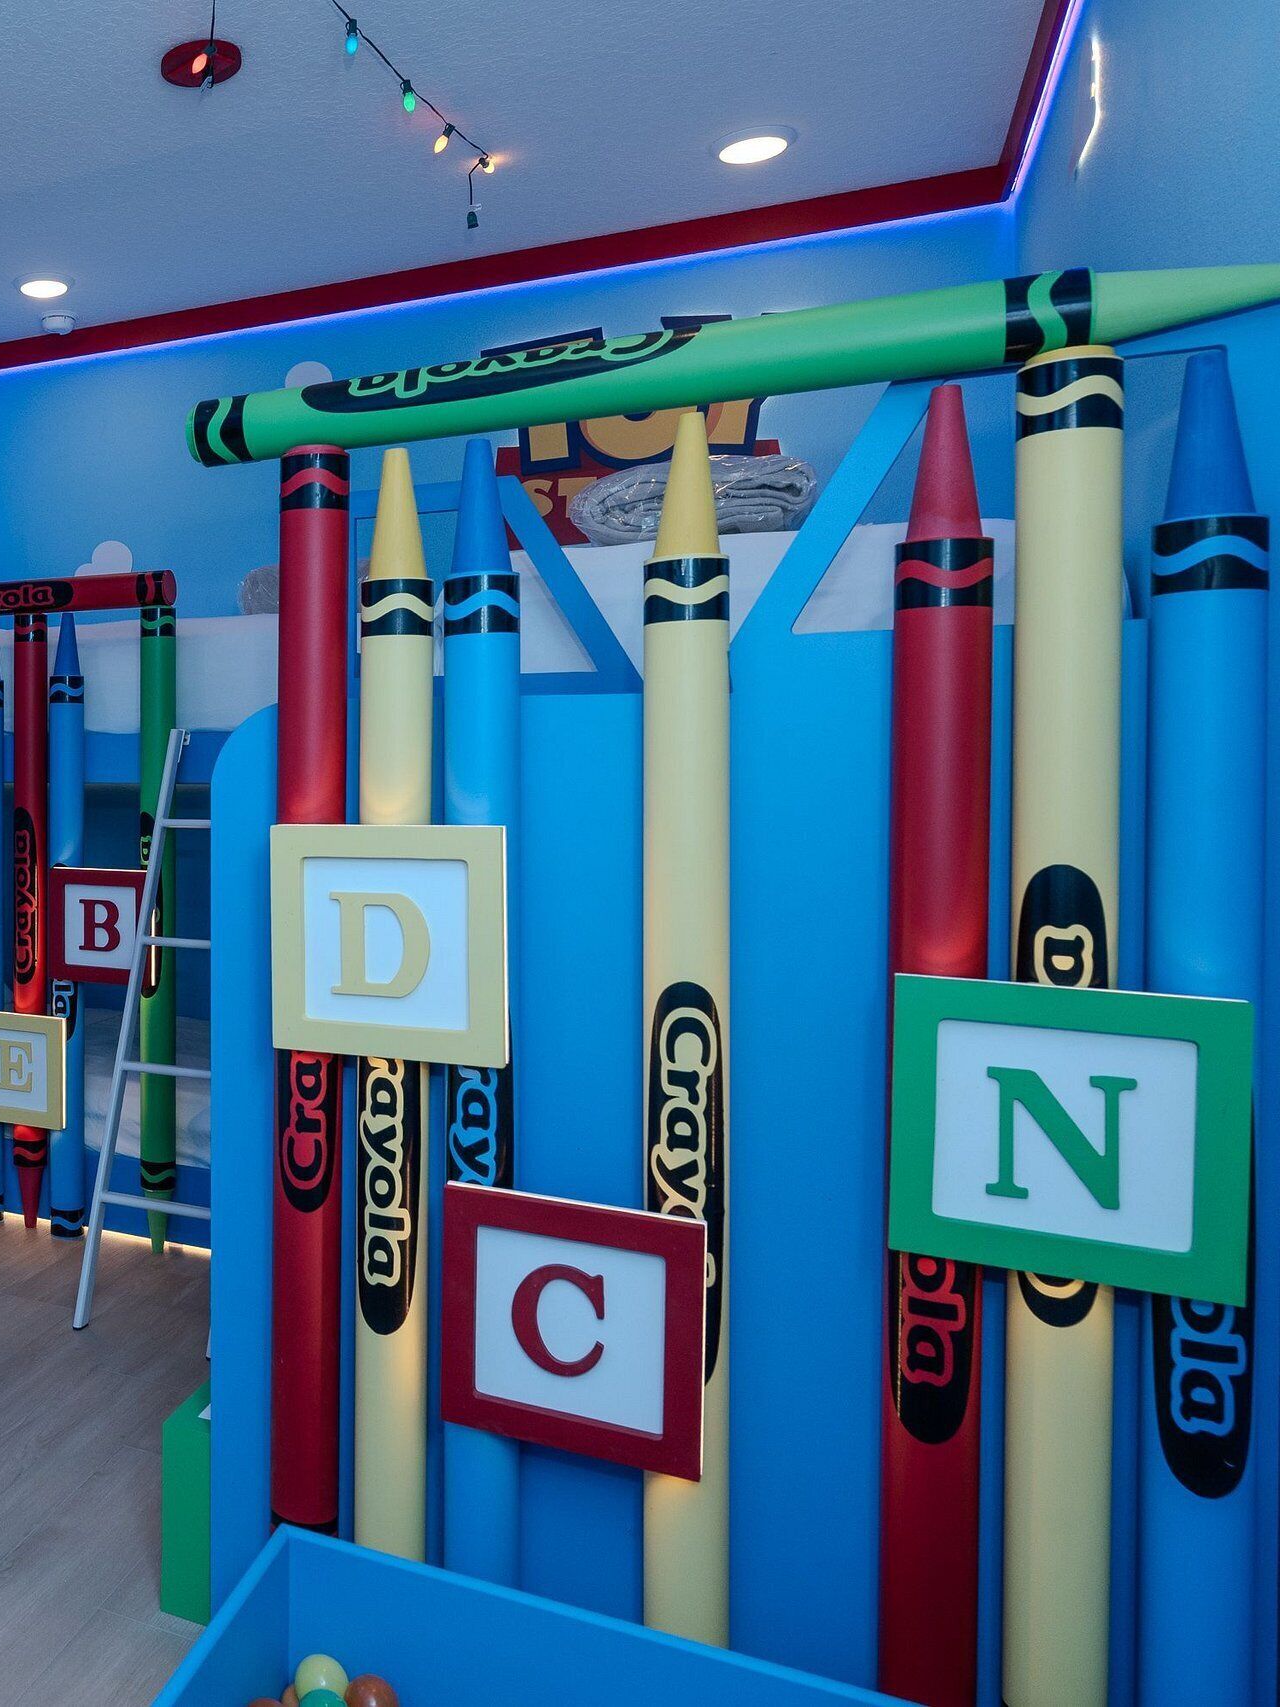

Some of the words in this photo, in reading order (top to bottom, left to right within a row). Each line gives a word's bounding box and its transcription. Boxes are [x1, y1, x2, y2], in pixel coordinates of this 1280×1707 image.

[15, 829, 37, 974] Crayola
[78, 898, 121, 952] B
[329, 891, 431, 999] D
[651, 1007, 716, 1222] Cray
[985, 1066, 1138, 1211] N
[511, 1263, 605, 1377] C
